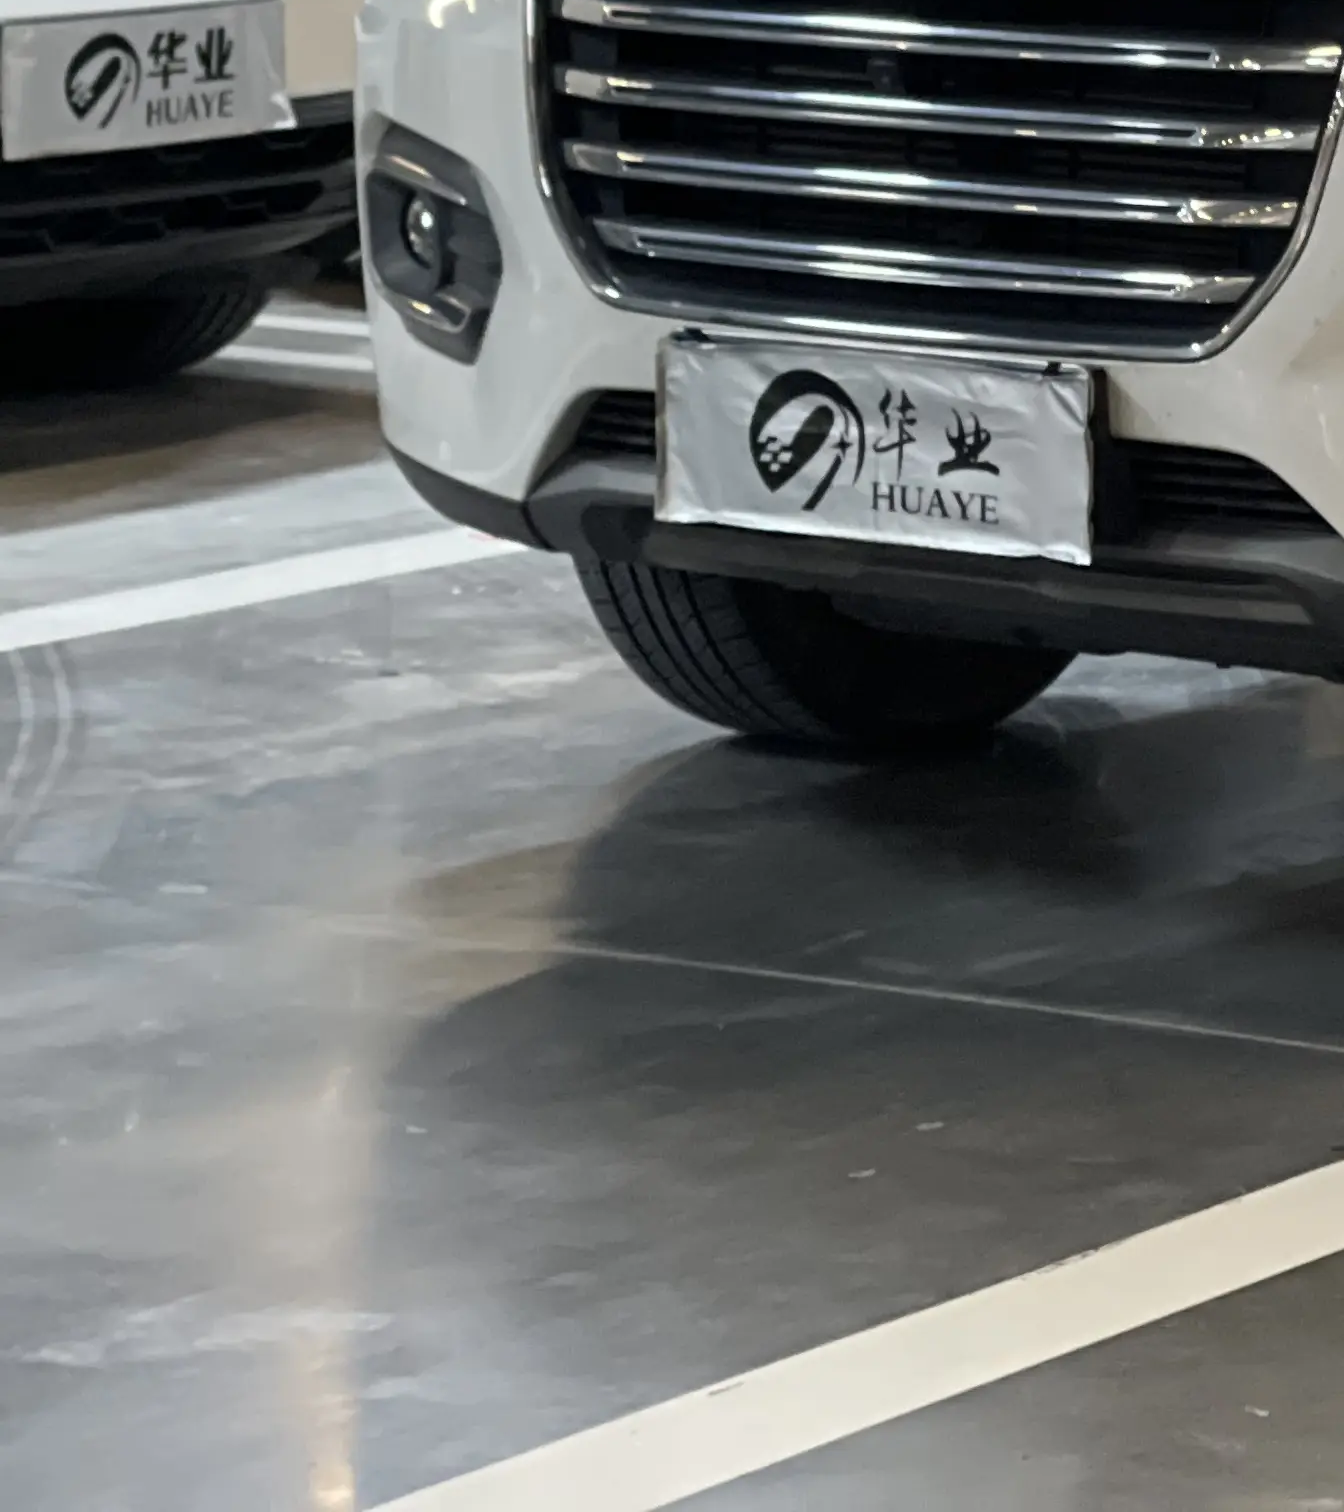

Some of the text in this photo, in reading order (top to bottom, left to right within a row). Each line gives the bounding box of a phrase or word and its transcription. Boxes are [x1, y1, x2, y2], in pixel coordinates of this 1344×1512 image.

[146, 26, 236, 89] 华业
[145, 88, 235, 129] HUAYE
[873, 388, 1000, 481] 华业
[871, 480, 1000, 525] HUAYE
